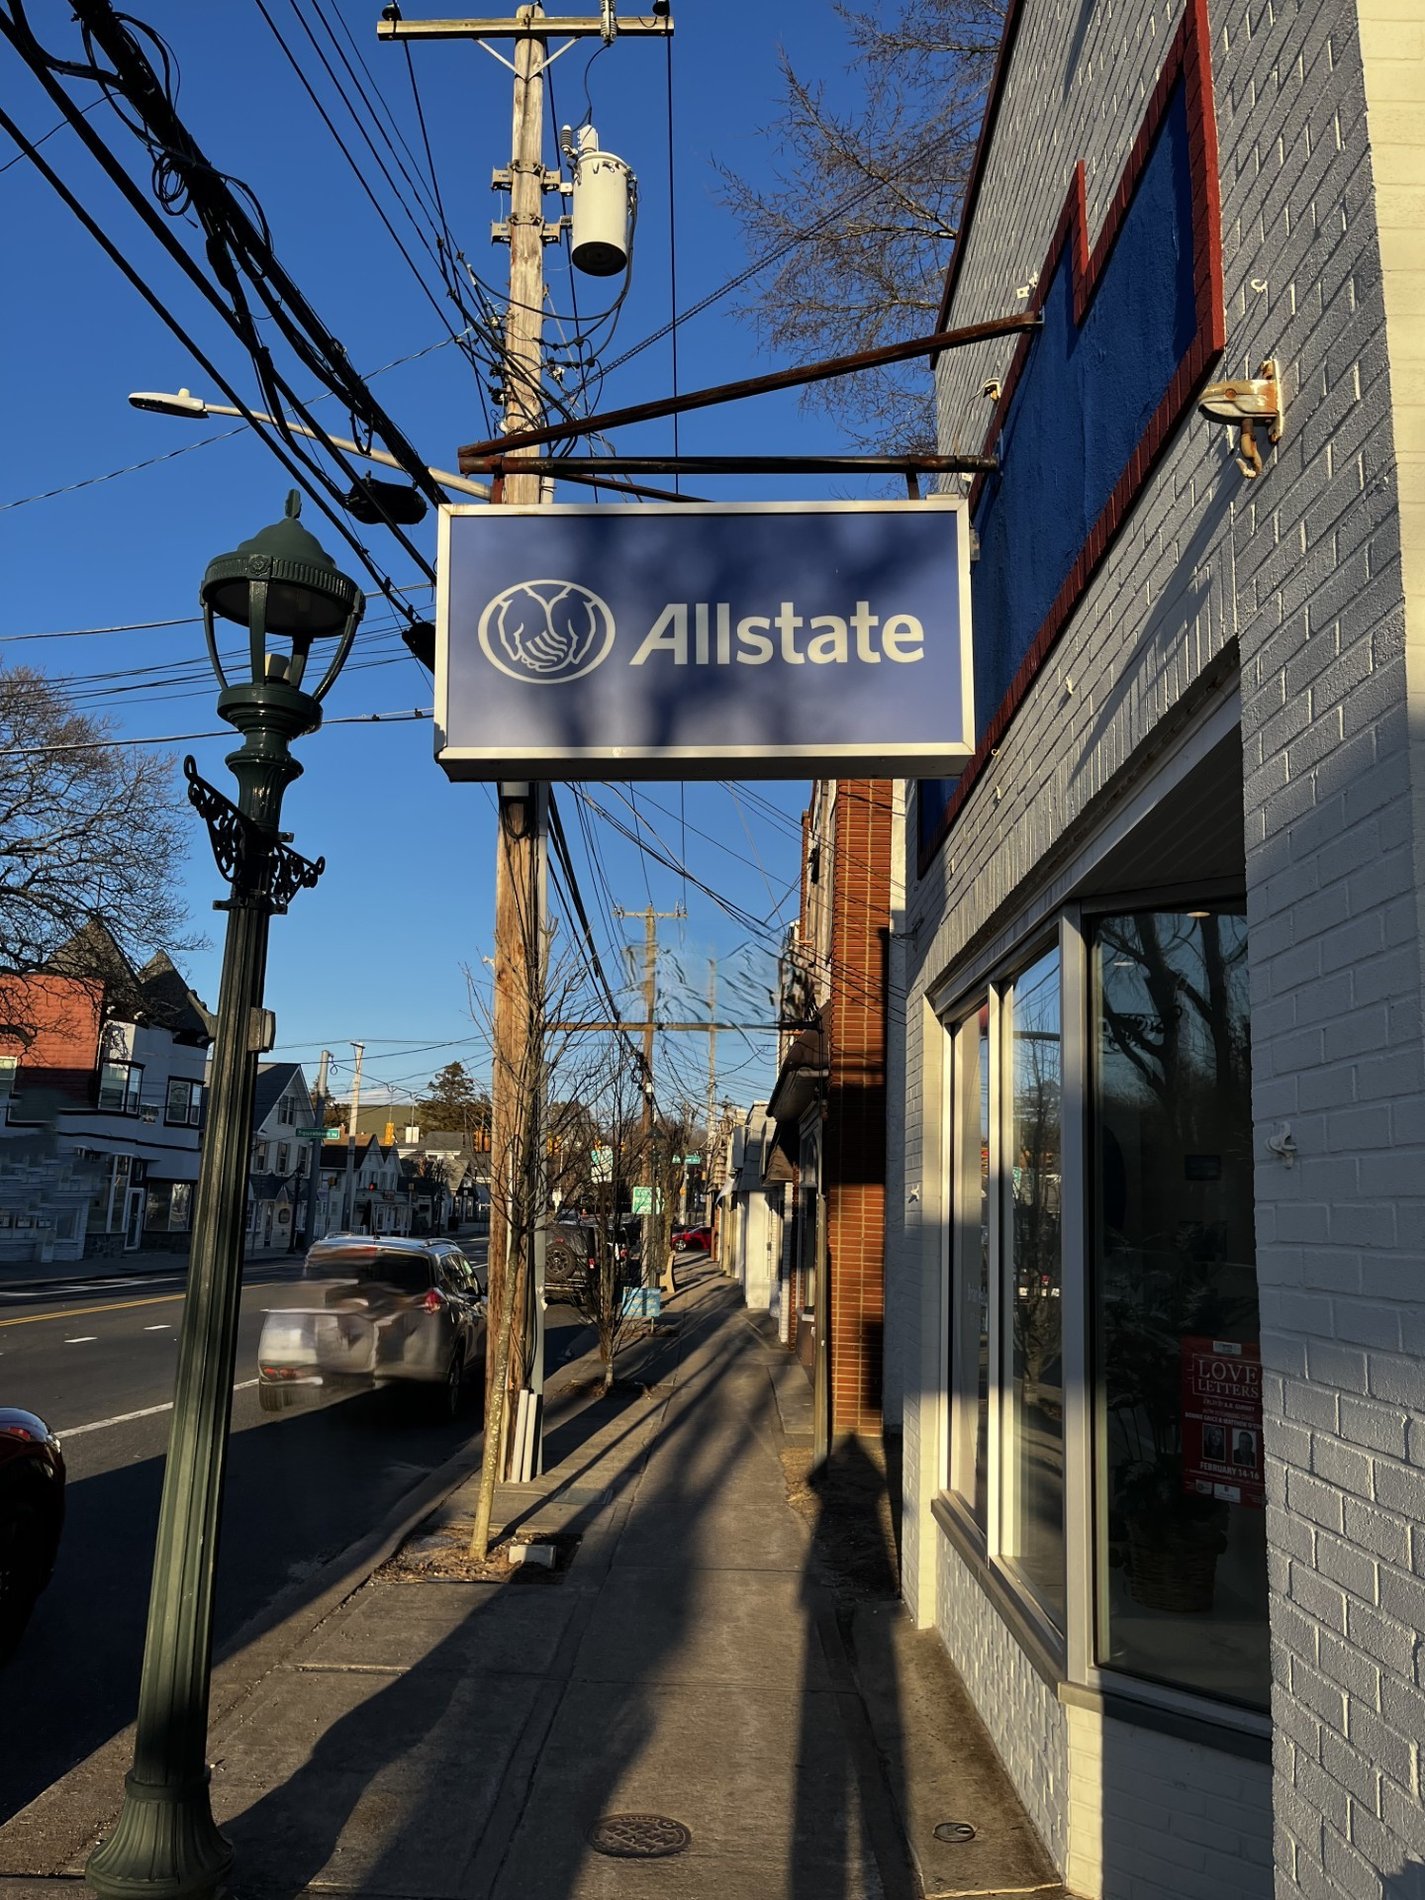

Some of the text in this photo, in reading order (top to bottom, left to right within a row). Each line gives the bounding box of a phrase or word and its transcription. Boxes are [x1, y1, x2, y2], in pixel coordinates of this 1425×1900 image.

[628, 600, 925, 666] Allstate
[1198, 1359, 1258, 1385] LOVE
[1198, 1379, 1259, 1399] LETTERS
[1199, 1461, 1237, 1476] FEBRUARY
[1238, 1468, 1260, 1481] 14-16
